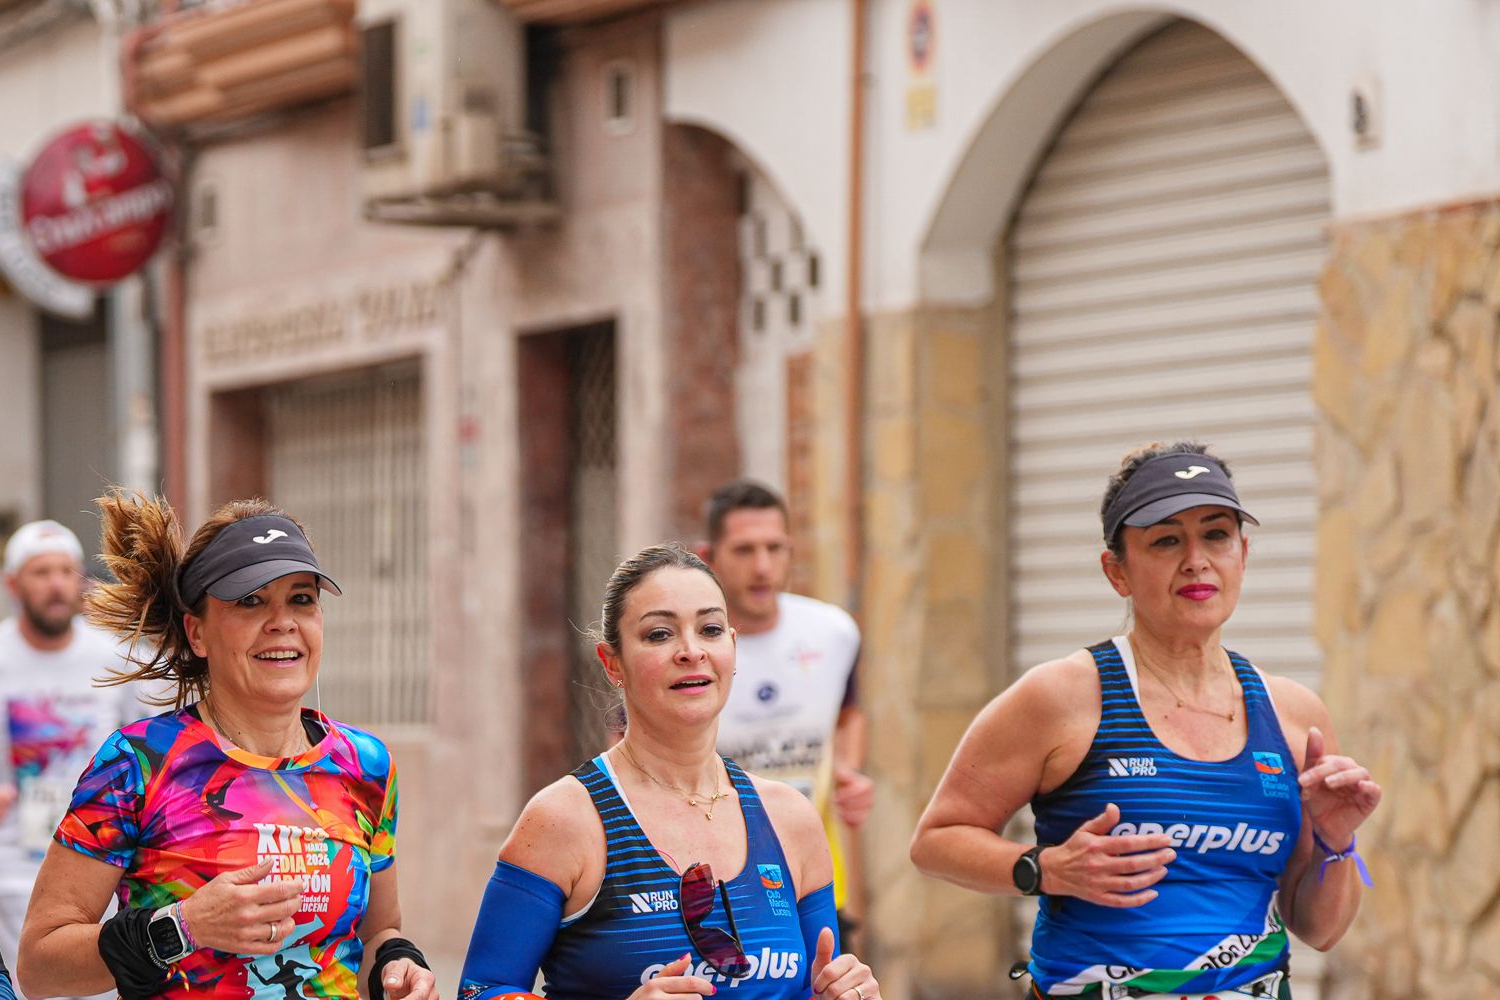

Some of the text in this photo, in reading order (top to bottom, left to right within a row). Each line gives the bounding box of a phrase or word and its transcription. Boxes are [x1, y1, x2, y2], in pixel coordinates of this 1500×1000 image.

[1129, 757, 1154, 767] RUN
[1132, 766, 1157, 776] PRO
[306, 853, 330, 866] 2026
[321, 895, 330, 903] de
[650, 890, 674, 901] RUN
[655, 899, 678, 911] PRO
